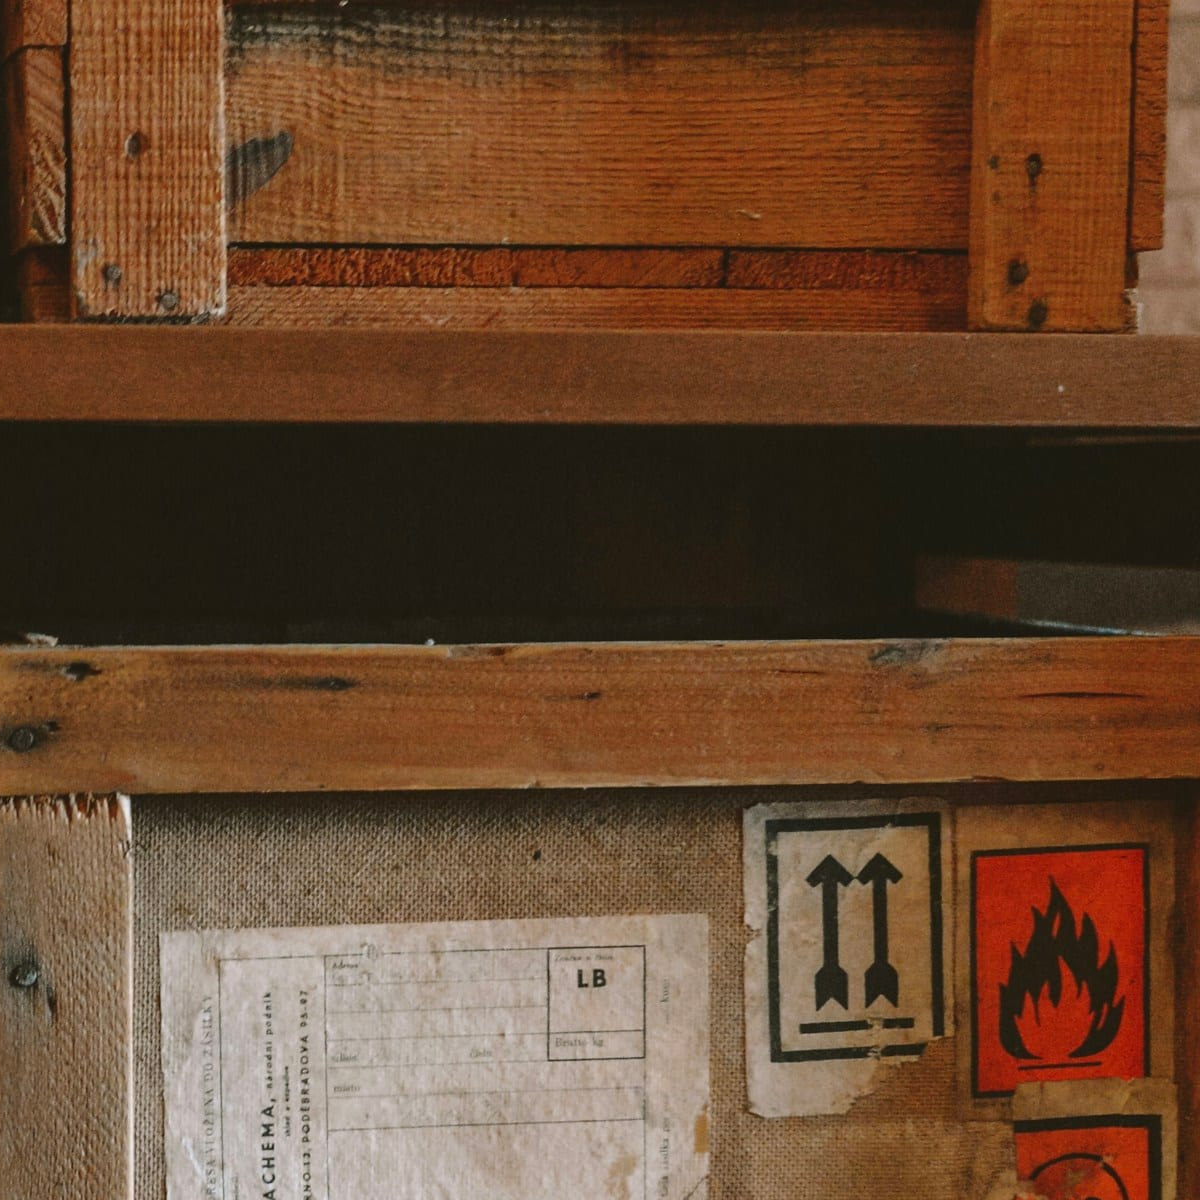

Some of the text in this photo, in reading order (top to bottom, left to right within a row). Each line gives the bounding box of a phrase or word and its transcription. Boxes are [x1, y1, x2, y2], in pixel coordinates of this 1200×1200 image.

[577, 968, 607, 988] LB
[264, 991, 274, 1036] podnik
[300, 1034, 311, 1144] PODĚBRADOVA
